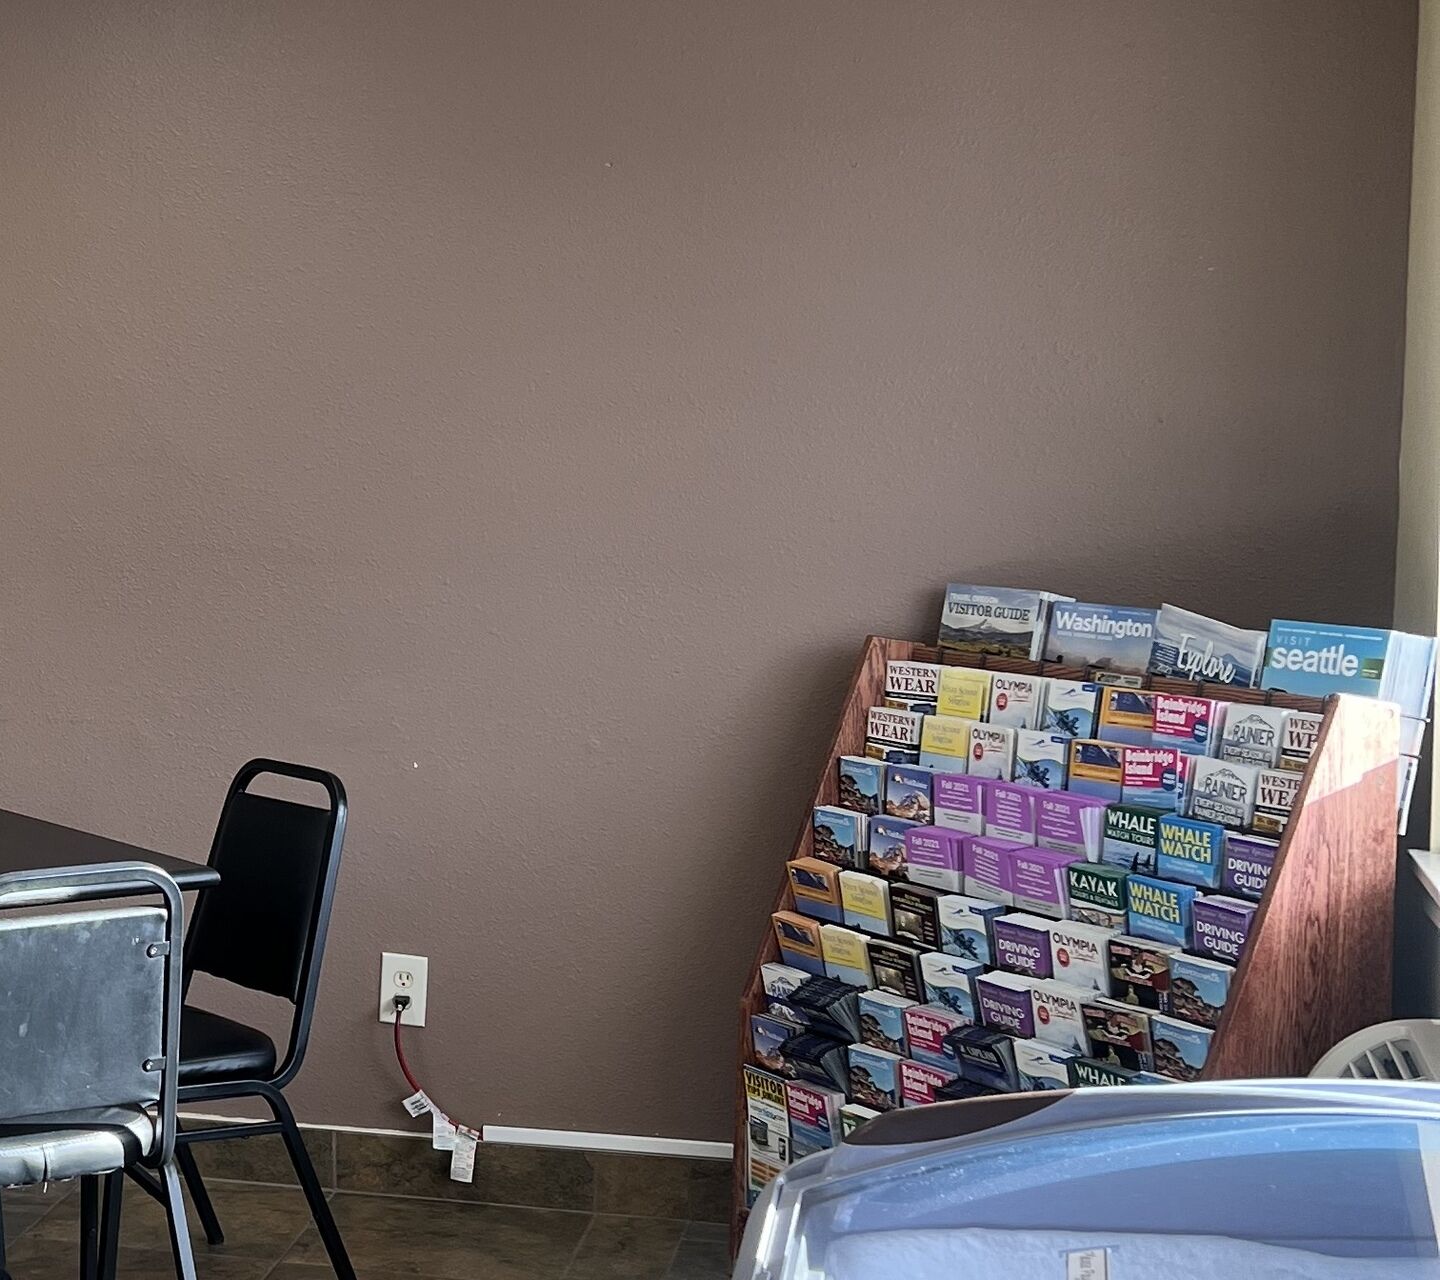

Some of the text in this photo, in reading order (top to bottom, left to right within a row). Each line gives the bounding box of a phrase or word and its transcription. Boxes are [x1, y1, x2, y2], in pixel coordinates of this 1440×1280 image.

[948, 602, 1030, 621] VISITOR GUIDE
[1056, 611, 1153, 638] Washington
[1276, 635, 1311, 646] VISIT
[1177, 634, 1237, 684] Explore
[1272, 645, 1359, 677] seattle
[889, 665, 938, 679] WESTERN
[889, 677, 936, 694] WEAR
[995, 679, 1033, 694] OLYMPIA
[1157, 695, 1207, 717] Bainbridge
[869, 711, 911, 726] WESTERN
[1156, 710, 1187, 725] Island
[869, 722, 909, 741] WEAR
[972, 728, 1006, 743] OLYMPIA
[1233, 723, 1275, 746] RAINIER
[1206, 778, 1247, 803] RAINIER
[1107, 808, 1157, 835] WHALE
[1106, 829, 1155, 846] WATCH TOURS
[1161, 823, 1211, 847] WHALE
[1161, 839, 1211, 864] WATCH
[1069, 871, 1118, 897] KAYAK
[1129, 881, 1178, 906] WHALE
[1129, 898, 1180, 924] WATCH
[1053, 932, 1098, 953] OLYMPIA
[1196, 920, 1245, 944] DRIVING
[998, 938, 1040, 959] DRIVING
[1204, 936, 1239, 955] GUIDE
[1005, 951, 1037, 970] GUIDE
[983, 998, 1025, 1019] DRIVING
[1033, 991, 1077, 1013] OLYMPIA
[990, 1011, 1021, 1030] GUIDE
[746, 1072, 785, 1097] VISITOR
